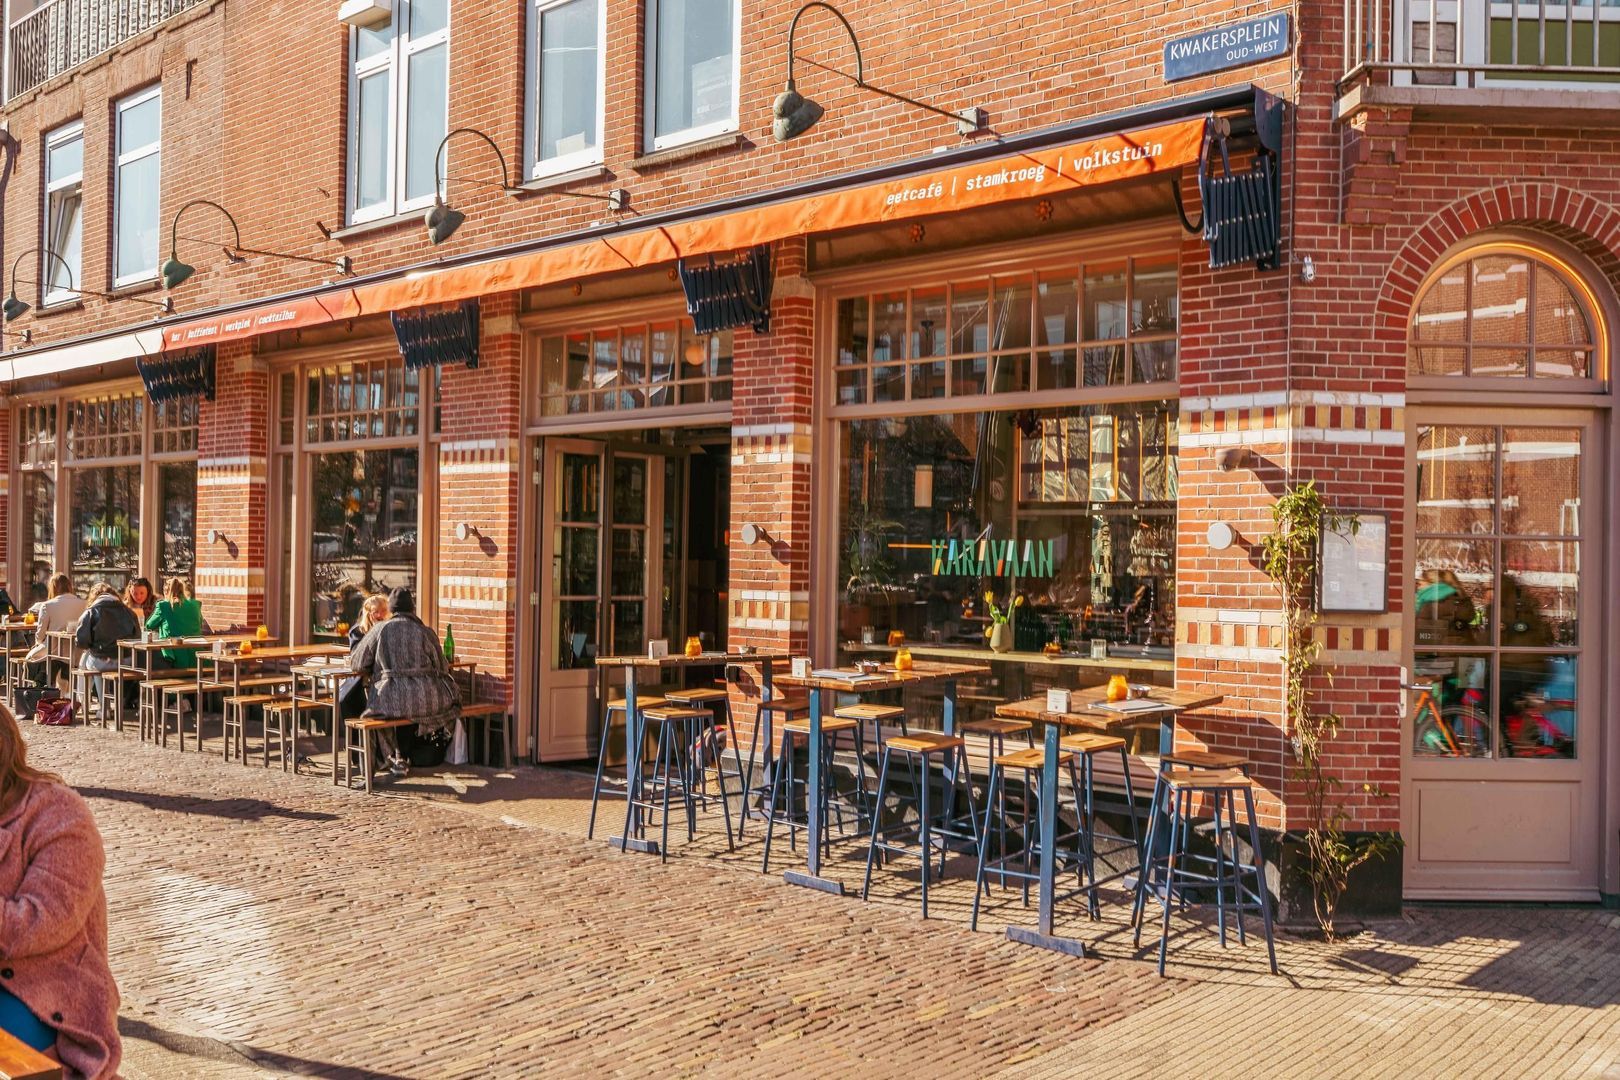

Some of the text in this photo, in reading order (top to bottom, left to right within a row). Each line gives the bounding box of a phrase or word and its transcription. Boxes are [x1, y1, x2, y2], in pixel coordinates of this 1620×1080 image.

[1170, 18, 1280, 61] KWAKERSPLEIN
[1226, 39, 1279, 61] OUD-WEST
[886, 181, 943, 205] eetcafé
[966, 164, 1046, 191] stamkroeg
[1073, 141, 1163, 171] volkstuin
[931, 539, 1054, 577] KARAVAAN
